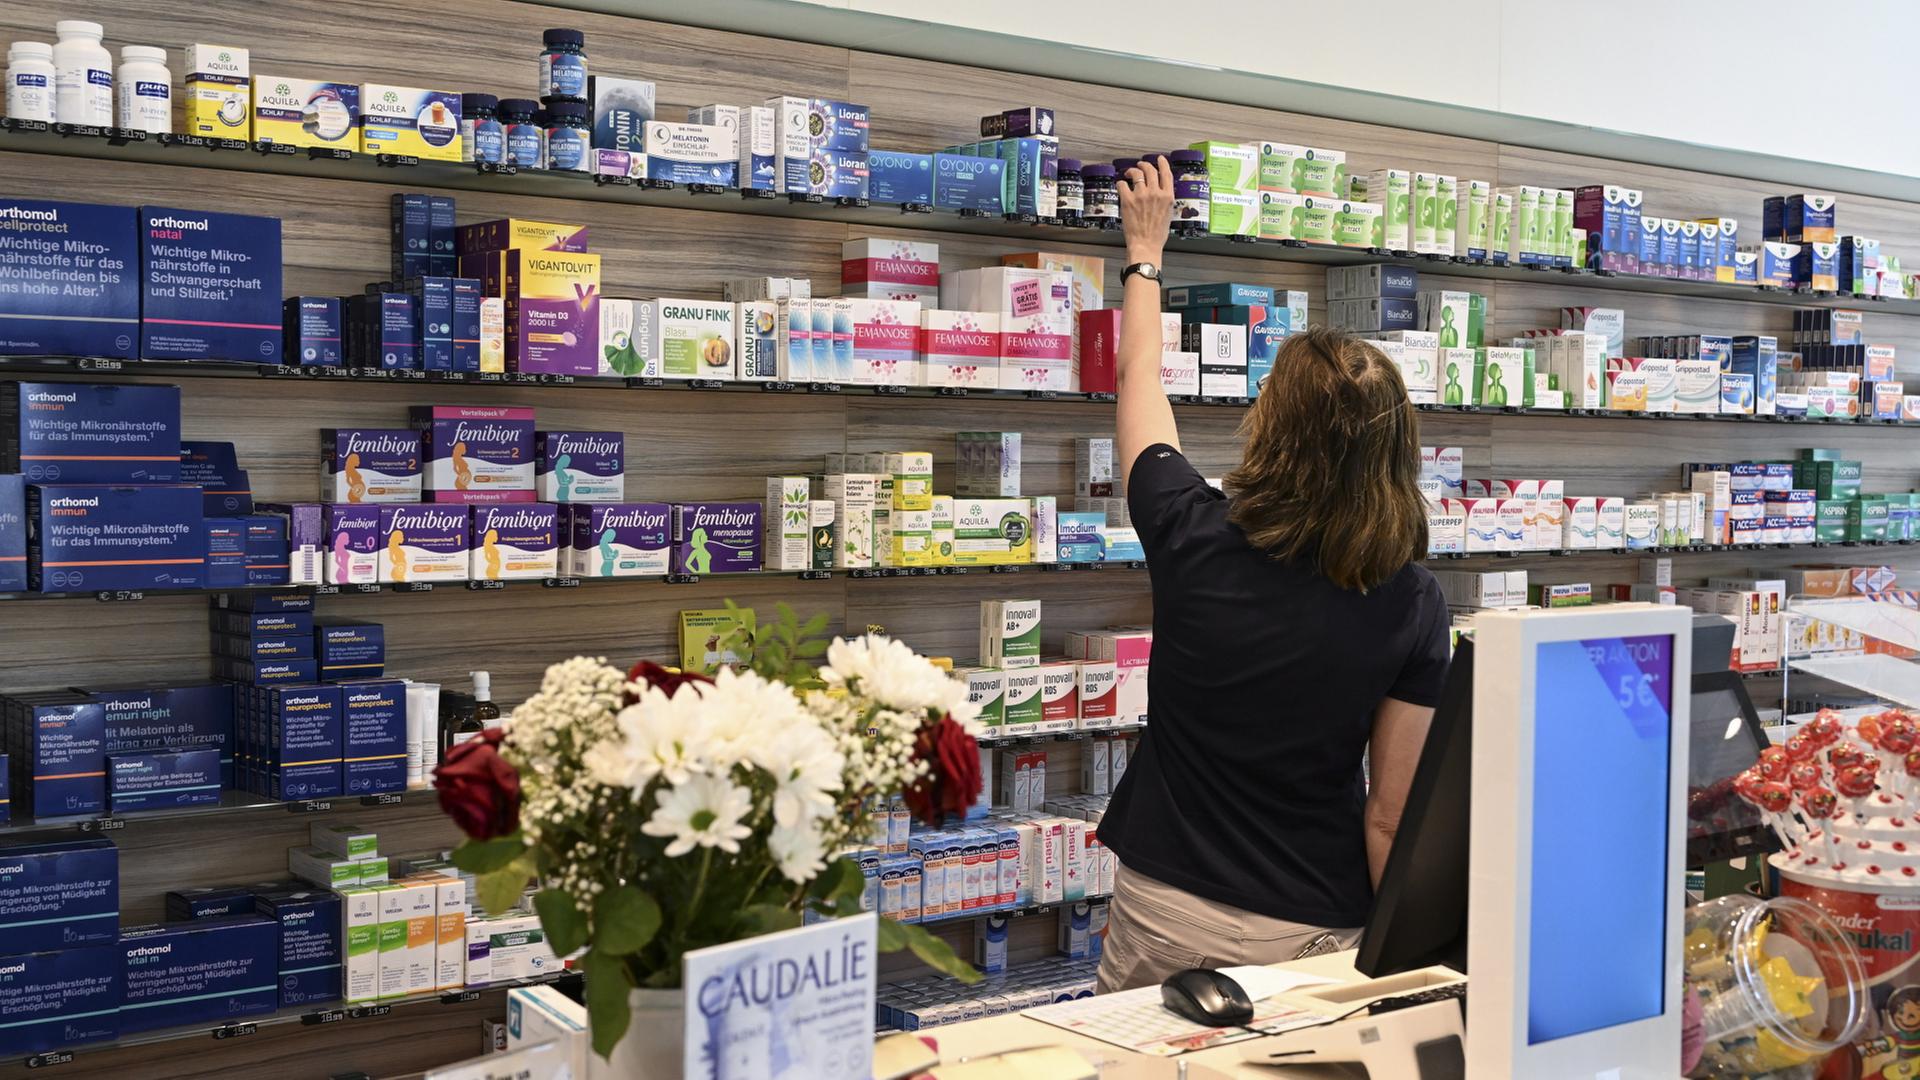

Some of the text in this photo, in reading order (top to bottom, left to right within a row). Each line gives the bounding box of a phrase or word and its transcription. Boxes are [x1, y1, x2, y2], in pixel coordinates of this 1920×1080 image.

[208, 62, 238, 71] AQUILEA
[139, 83, 168, 91] pure
[263, 96, 299, 106] AQUILEA
[370, 103, 406, 113] AQUILEA
[839, 108, 865, 120] Lioran
[369, 116, 391, 124] SCHLAF
[673, 135, 709, 143] MELATONIN
[664, 149, 718, 158] SCHMELZTABLETTEN
[839, 158, 865, 169] Lioran
[869, 156, 912, 170] OYONO
[940, 159, 984, 174] OYONO
[0, 207, 57, 221] orthomol
[0, 220, 68, 233] cellprotect
[150, 216, 208, 231] orthomol
[151, 228, 183, 241] natal
[517, 227, 556, 236] VIGANTOLVIT
[0, 236, 111, 254] Wichtige Mikro-
[151, 245, 252, 263] Wichtige Mikro-
[0, 252, 123, 269] nährstoffe für das
[151, 259, 231, 274] nährstoffe in
[528, 259, 594, 274] VIGANTOLVIT
[875, 261, 929, 275] FEMANNOSE
[0, 267, 120, 283] Wohlbefinden bis
[151, 271, 262, 290] Schwangerschaft
[1386, 276, 1412, 287] Bianacid
[23, 283, 58, 295] hohe
[151, 286, 176, 298] und
[1237, 287, 1268, 298] GAVISCON
[528, 310, 569, 320] Vitamin D3
[663, 306, 731, 322] GRANU FINK
[1386, 310, 1413, 320] Bianacid
[1592, 313, 1617, 322] Grippostad
[528, 319, 546, 327] 2000
[639, 303, 652, 359] Gingium
[665, 326, 688, 338] Blase
[854, 327, 911, 340] FEMANNOSE
[1254, 325, 1286, 335] GAVISCON
[745, 308, 755, 377] GRANU FINK
[935, 333, 990, 347] FEMANNOSE
[1405, 336, 1436, 348] Bianacid
[1490, 350, 1521, 360] GeloMyrtol
[79, 360, 121, 370] € 68.99
[1641, 364, 1668, 372] Grippostad
[1675, 366, 1710, 375] Grippostad
[1617, 377, 1646, 385] Grippostad
[28, 392, 76, 403] orthomol
[29, 402, 64, 411] immun
[461, 409, 498, 417] Vorteilspack
[29, 420, 167, 432] Wichtige Mikronährstoffe
[29, 431, 44, 441] für
[48, 431, 68, 441] das
[448, 422, 519, 446] femibion
[339, 432, 416, 458] femibion
[550, 435, 619, 458] femibion
[408, 459, 416, 469] 2
[1733, 465, 1748, 474] ACC
[1767, 466, 1779, 474] ACC
[1839, 468, 1859, 477] ASPIRIN
[50, 497, 98, 508] orthomol
[51, 507, 87, 516] immun
[1628, 509, 1657, 520] Soledum
[1824, 506, 1847, 516] ASPIRIN
[334, 517, 376, 530] femibion
[383, 508, 464, 535] femibion
[478, 508, 552, 534] femibion
[594, 508, 664, 532] femibion
[687, 506, 753, 530] femibion
[51, 524, 190, 536] Wichtige Mikronährstoffe
[713, 529, 753, 538] menopause
[1060, 524, 1096, 533] Imodium
[51, 536, 67, 547] für
[70, 536, 90, 546] das
[1006, 609, 1037, 620] Innovall
[257, 617, 285, 625] orthomol
[1006, 622, 1020, 631] AB+
[1044, 673, 1073, 684] Innovall
[1044, 686, 1057, 694] RDS
[286, 696, 319, 704] orthomol
[286, 702, 332, 711] neuroprotect
[120, 723, 194, 737] Melatonin als
[164, 733, 225, 746] Verkürzung
[1068, 827, 1076, 860] nasic
[23, 879, 112, 894] Mikronährstoffe zur
[61, 888, 106, 899] Müdigkeit
[127, 944, 171, 957] orthomol
[128, 955, 148, 965] vital
[128, 958, 253, 980] Wichtige Mikronährstoffe zur
[128, 976, 185, 989] Verringerung
[205, 967, 247, 981] Müdigkeit
[127, 989, 144, 998] und
